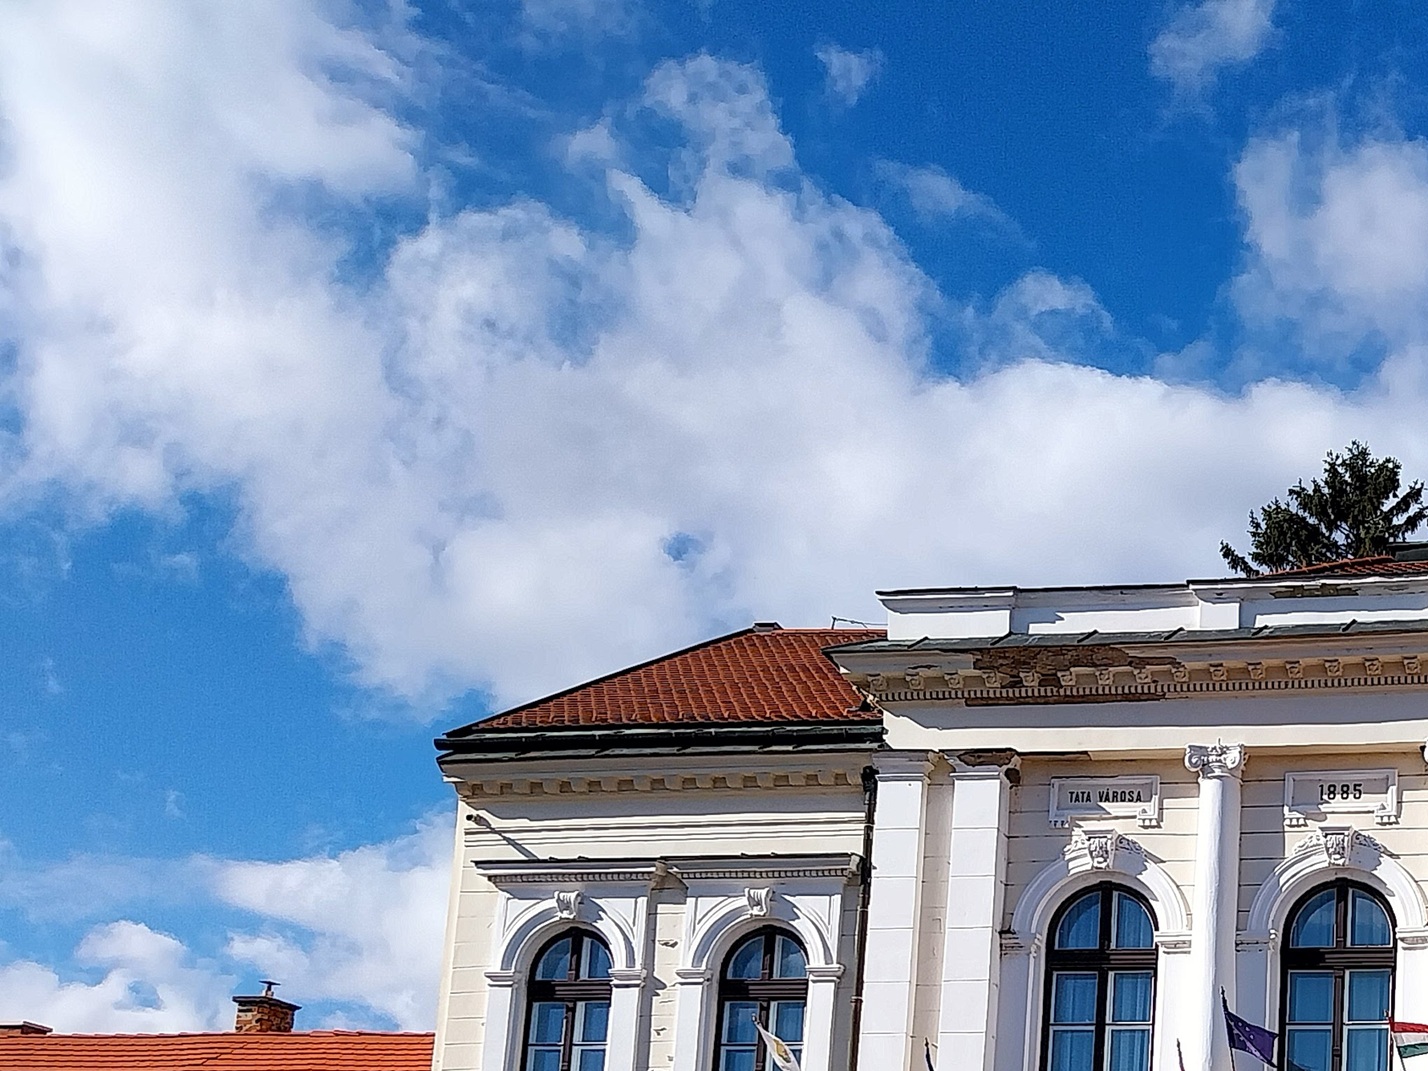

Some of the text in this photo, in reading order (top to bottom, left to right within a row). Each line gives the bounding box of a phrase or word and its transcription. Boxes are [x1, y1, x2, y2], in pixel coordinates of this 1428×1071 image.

[1068, 787, 1142, 804] TATA VÁROSA
[1318, 783, 1363, 801] 1885
